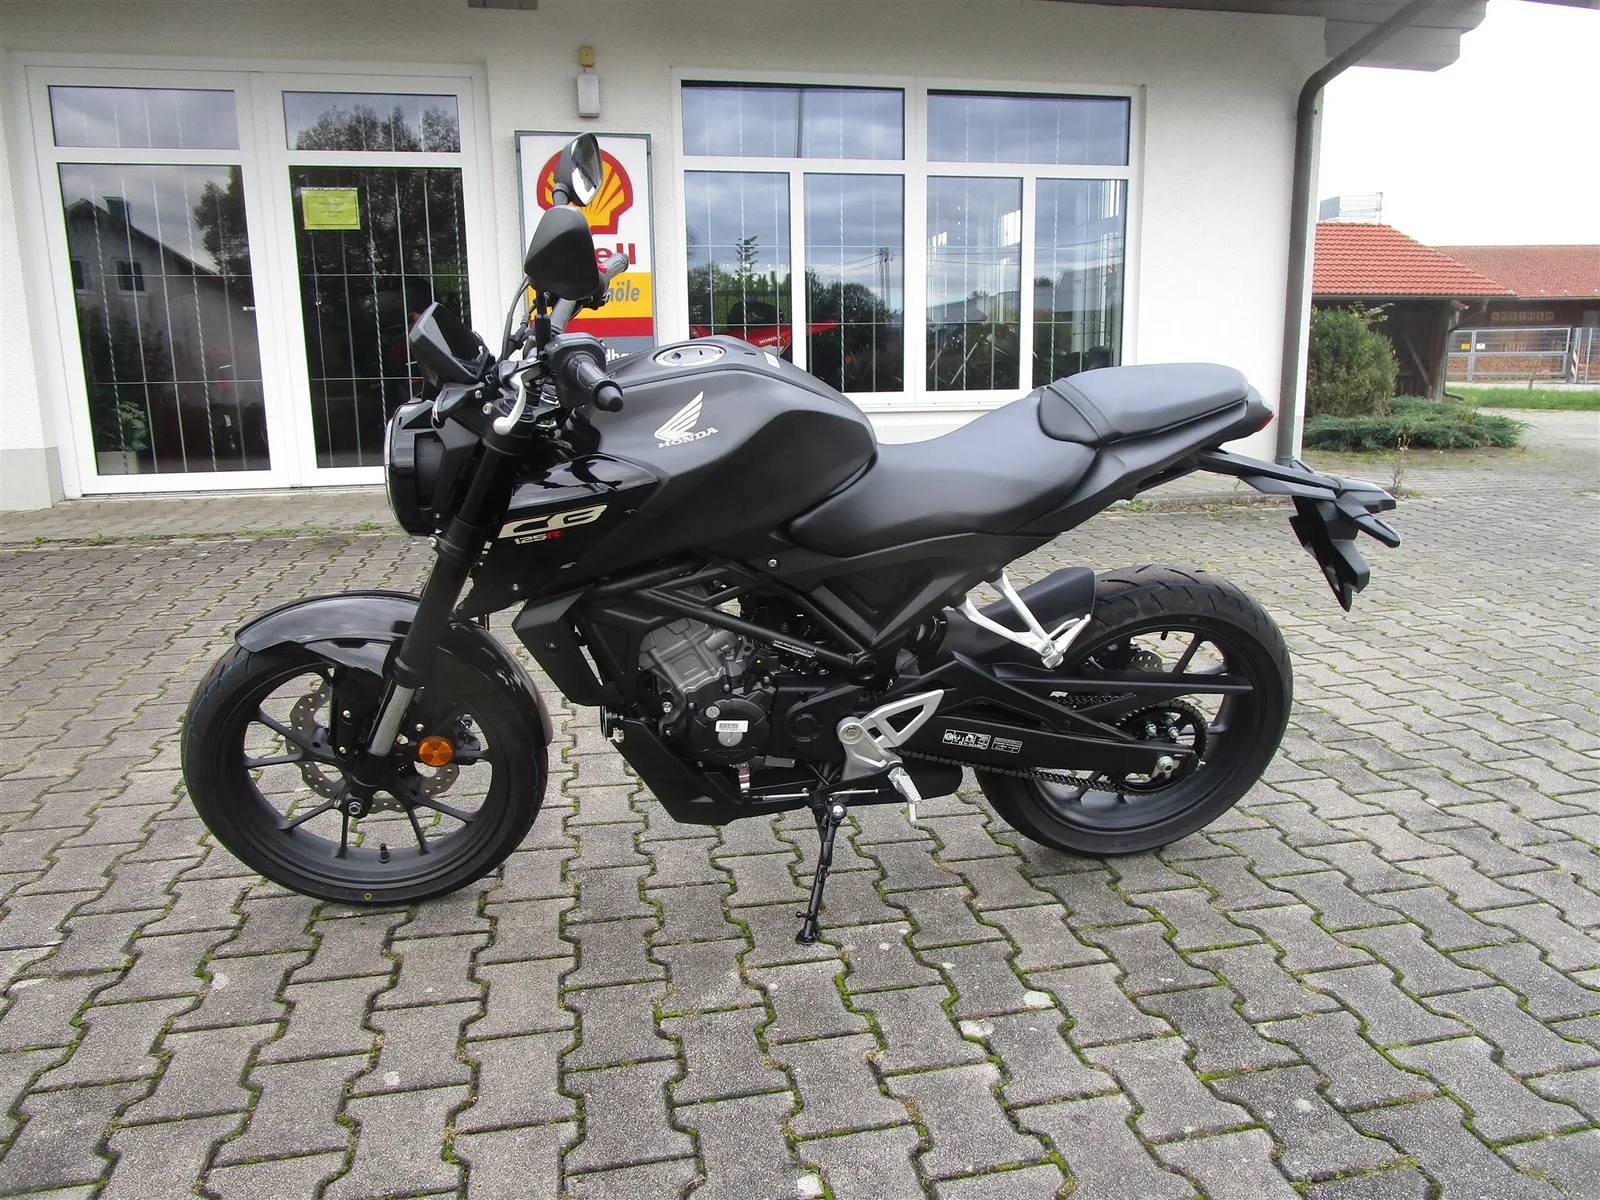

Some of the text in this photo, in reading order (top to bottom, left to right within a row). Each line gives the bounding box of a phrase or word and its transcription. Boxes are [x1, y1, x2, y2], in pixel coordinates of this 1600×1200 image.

[594, 243, 636, 264] ell
[656, 427, 719, 449] HONDA
[498, 504, 608, 539] CB
[514, 531, 561, 545] 125R
